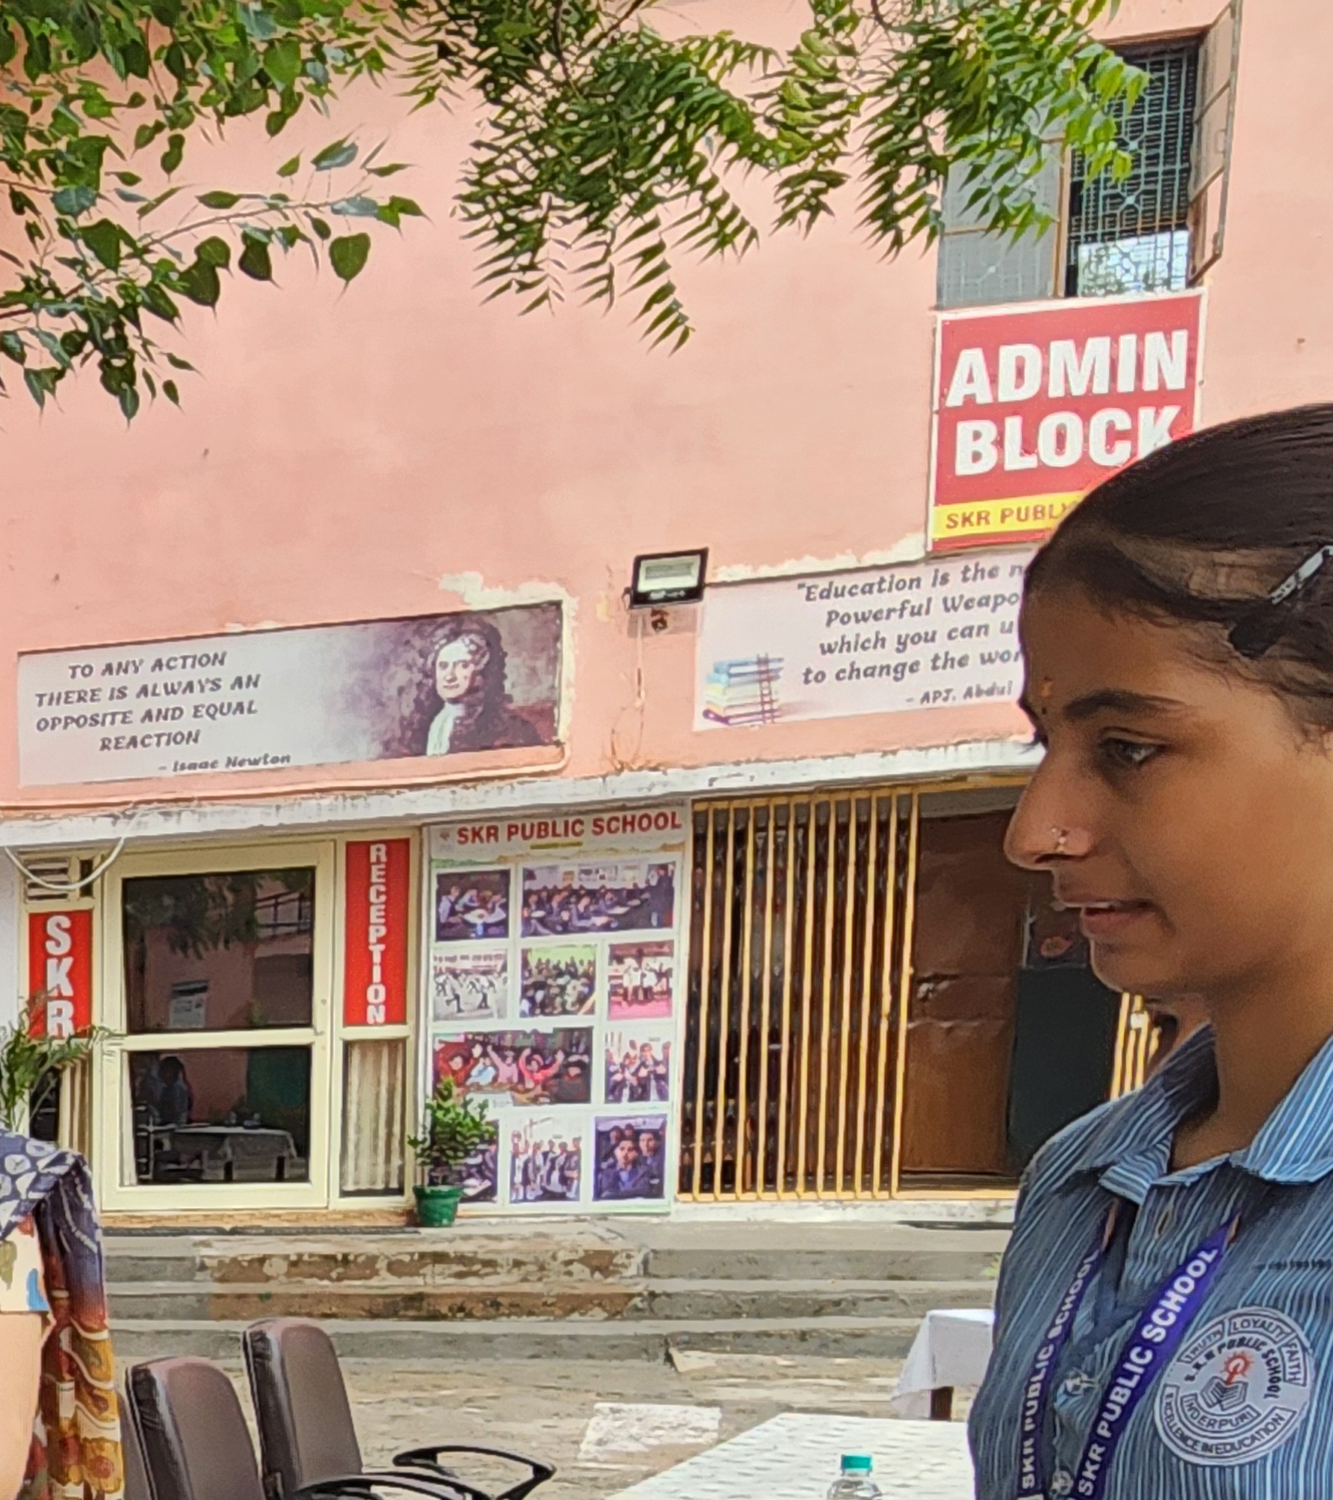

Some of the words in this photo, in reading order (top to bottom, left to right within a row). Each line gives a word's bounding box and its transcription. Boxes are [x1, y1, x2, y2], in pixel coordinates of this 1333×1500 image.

[945, 329, 1188, 407] ADMIN
[955, 405, 1181, 476] BLOCK
[945, 509, 991, 530] SKR
[931, 568, 950, 588] is
[961, 561, 1000, 583] the
[825, 596, 933, 628] Powerful
[942, 591, 1021, 613] Weapo
[819, 629, 887, 656] which
[895, 628, 938, 654] you
[946, 620, 990, 641] can
[67, 663, 94, 680] TO
[100, 658, 145, 677] ANY
[150, 650, 228, 673] ACTION
[802, 666, 827, 686] to
[834, 660, 921, 682] change
[930, 650, 970, 673] the
[979, 648, 1022, 666] wor
[35, 687, 103, 708] THERE
[108, 685, 129, 702] IS
[135, 677, 223, 699] ALWAYS
[229, 673, 262, 690] AN
[962, 680, 1014, 701] Abdul
[35, 709, 134, 732] OPPOSITE
[139, 705, 185, 724] AND
[191, 699, 259, 721] EQUAL
[98, 729, 202, 752] REACTION
[172, 757, 220, 773] Isaac
[224, 752, 292, 769] Newton
[456, 824, 500, 846] SKR
[506, 818, 586, 842] PUBLIC
[591, 810, 683, 836] SCHOOL
[366, 843, 388, 1025] RECEPTION
[45, 914, 75, 1040] SKR
[1078, 1442, 1107, 1497] SKR
[1097, 1346, 1154, 1439] PUBLIC
[1141, 1248, 1219, 1344] SCHOOL
[1261, 1348, 1283, 1399] SCHOOL
[1286, 1342, 1303, 1383] FAITH
[1215, 1413, 1285, 1455] EDUCATION
